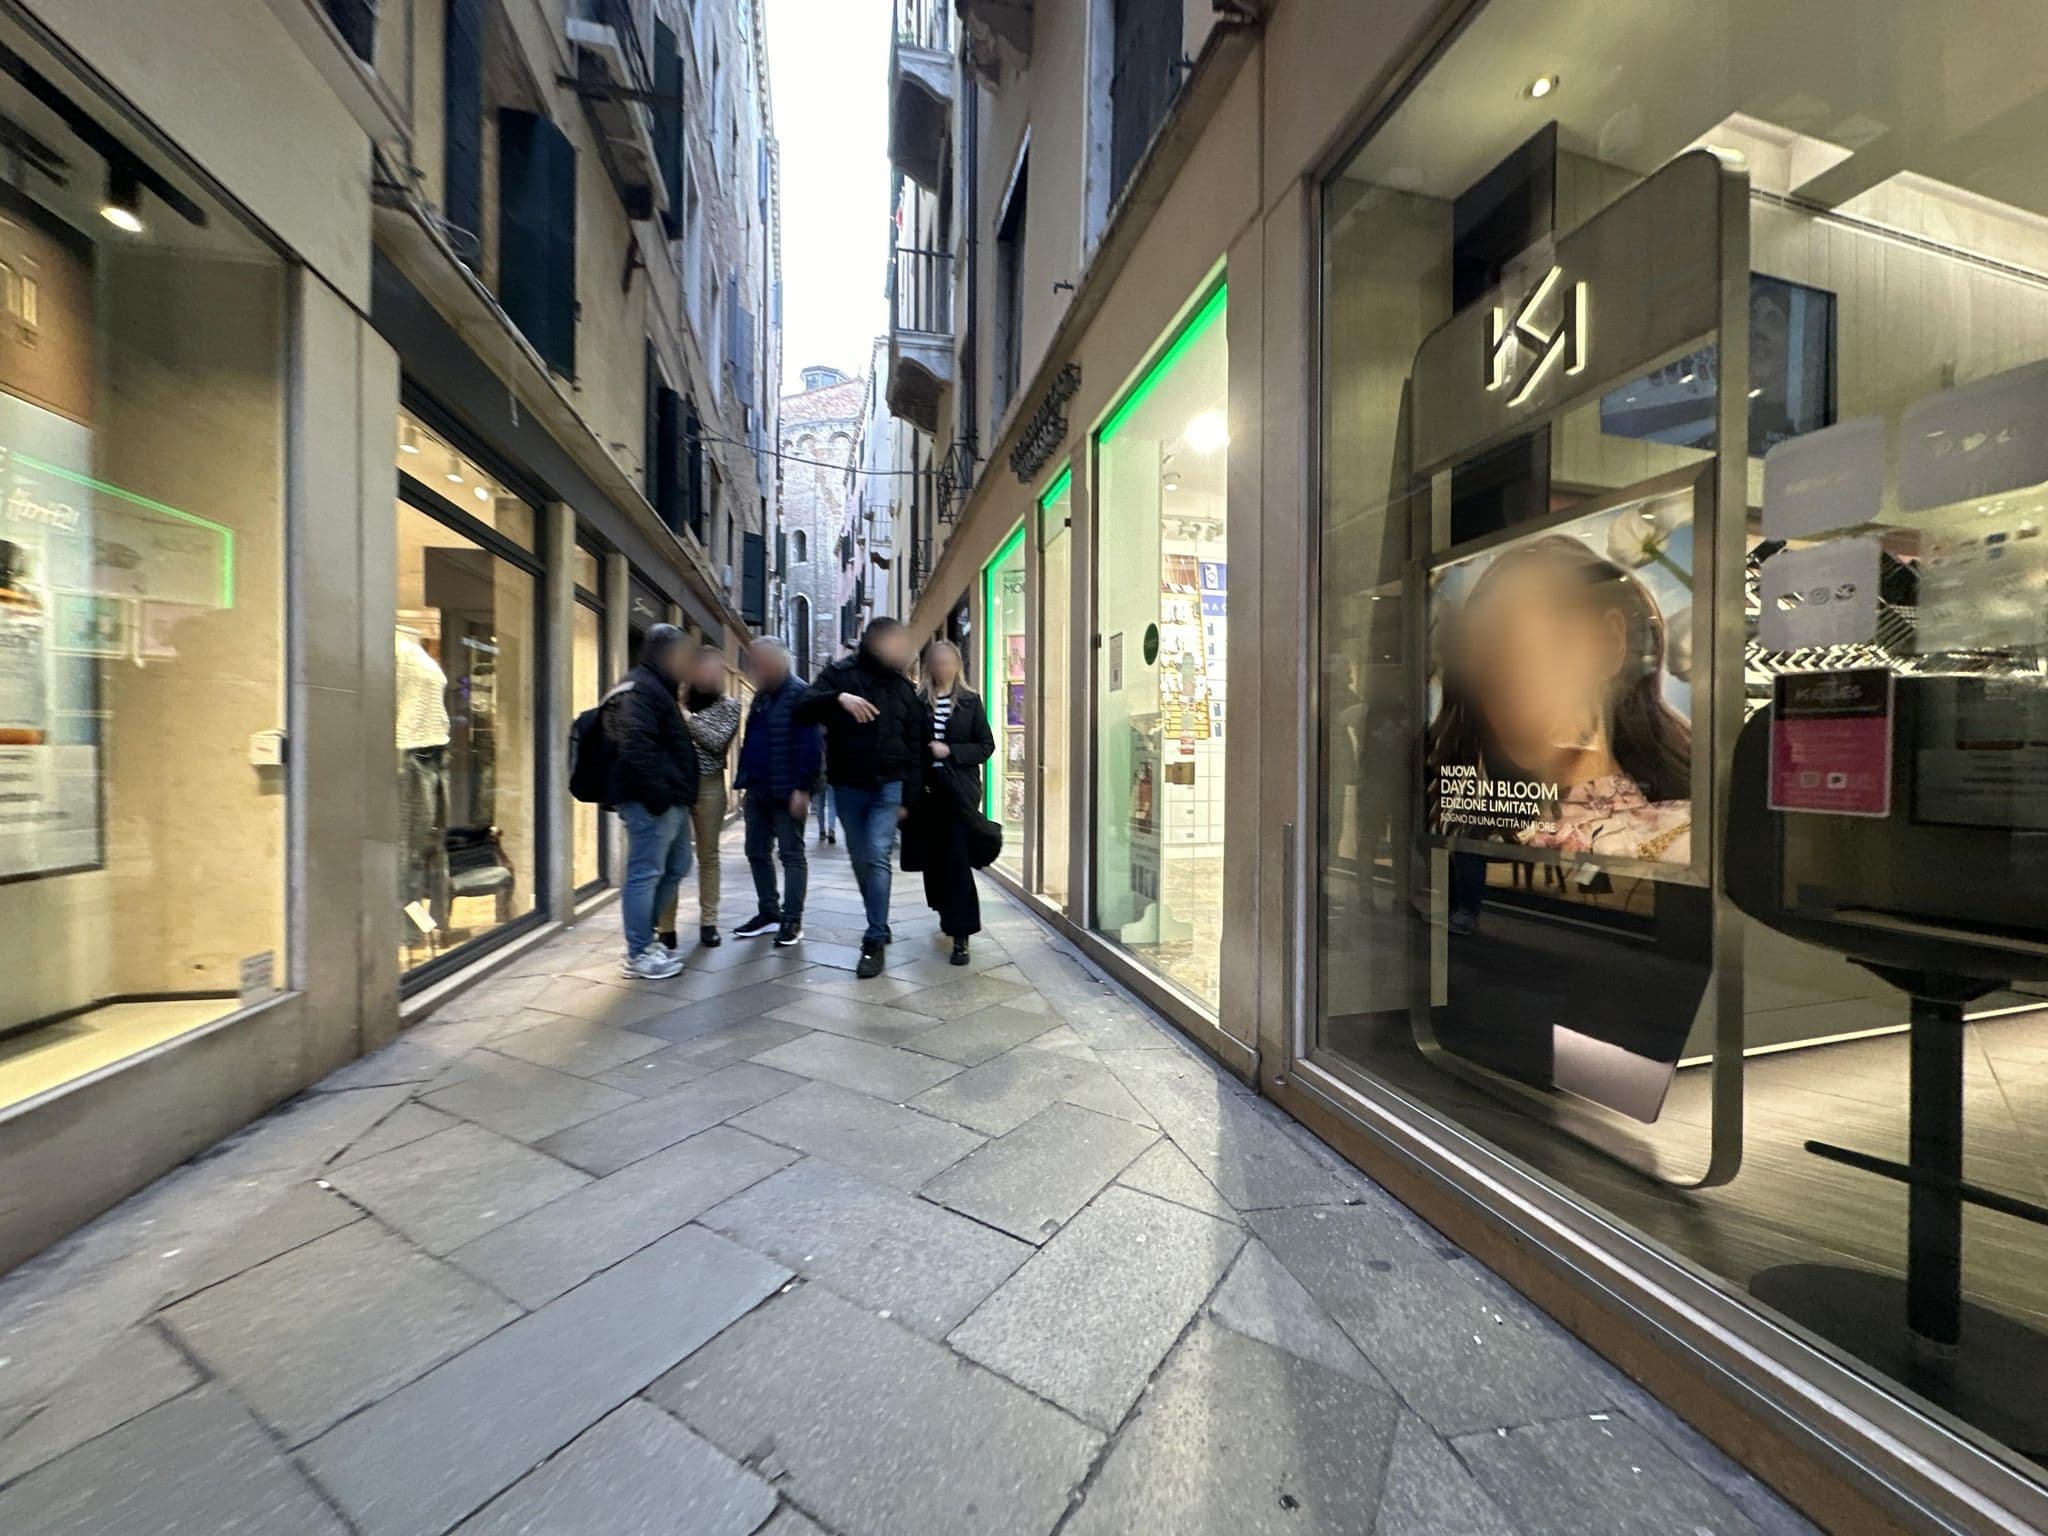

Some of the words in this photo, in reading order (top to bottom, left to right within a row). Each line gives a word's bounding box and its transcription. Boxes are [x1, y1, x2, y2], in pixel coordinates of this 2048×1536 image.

[1440, 765, 1477, 777] NUOVA
[1440, 779, 1475, 796] DAYS
[1478, 781, 1494, 796] IN
[1497, 781, 1558, 800] BLOOM
[1440, 797, 1488, 811] EDIZIONE
[1489, 800, 1540, 816] LIMITATA
[1440, 812, 1468, 824] SOGNO
[1478, 814, 1496, 826] UNA
[1496, 815, 1520, 829] CITTÀ
